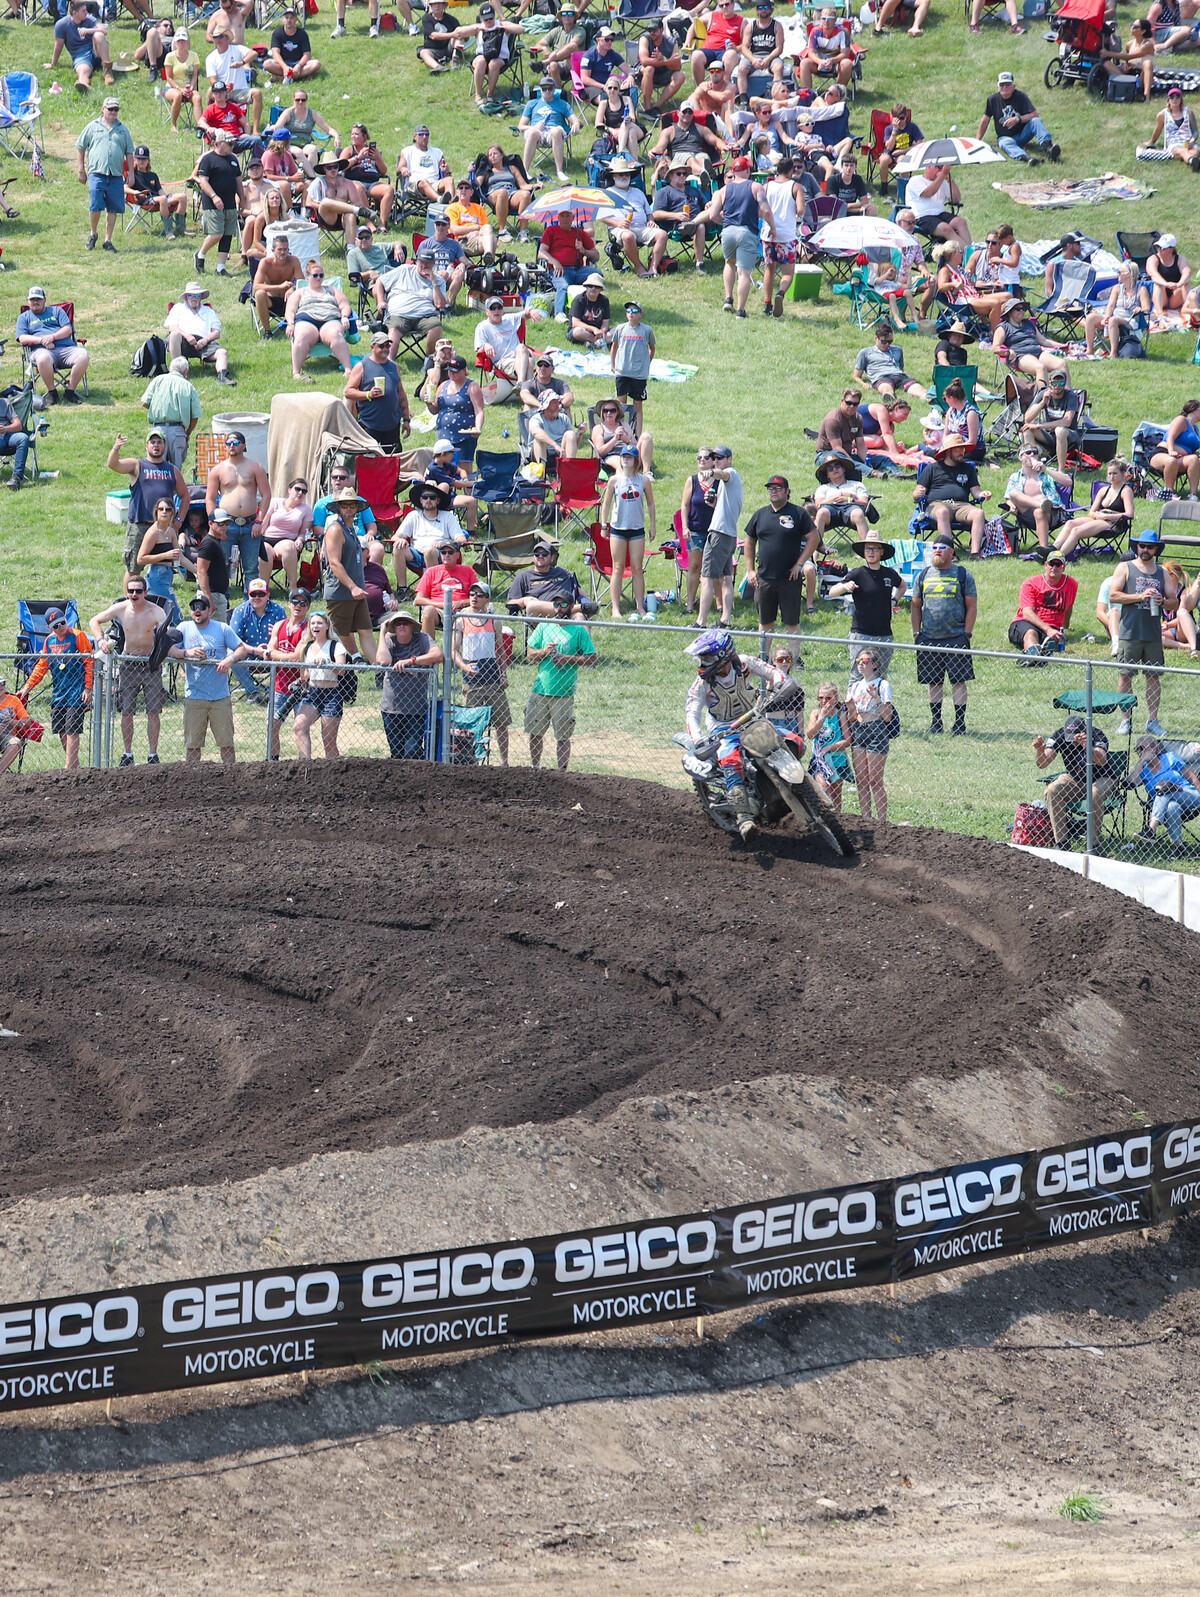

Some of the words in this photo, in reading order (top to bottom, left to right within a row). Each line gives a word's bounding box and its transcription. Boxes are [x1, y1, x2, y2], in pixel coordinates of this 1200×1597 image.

[683, 756, 714, 778] 962
[1036, 1135, 1152, 1197] GEICO
[894, 1163, 1022, 1227] GEICO
[732, 1191, 877, 1254] GEICO
[1048, 1201, 1141, 1236] MOTORCYCLE
[554, 1219, 717, 1283] GEICO
[914, 1228, 1003, 1267] MOTORCYCLE
[361, 1247, 536, 1308] GEICO
[746, 1257, 857, 1295] MOTORCYCLE
[162, 1270, 340, 1335] GEICO
[573, 1286, 696, 1325] MOTORCYCLE
[381, 1313, 509, 1350] MOTORCYCLE
[184, 1339, 316, 1377] MOTORCYCLE
